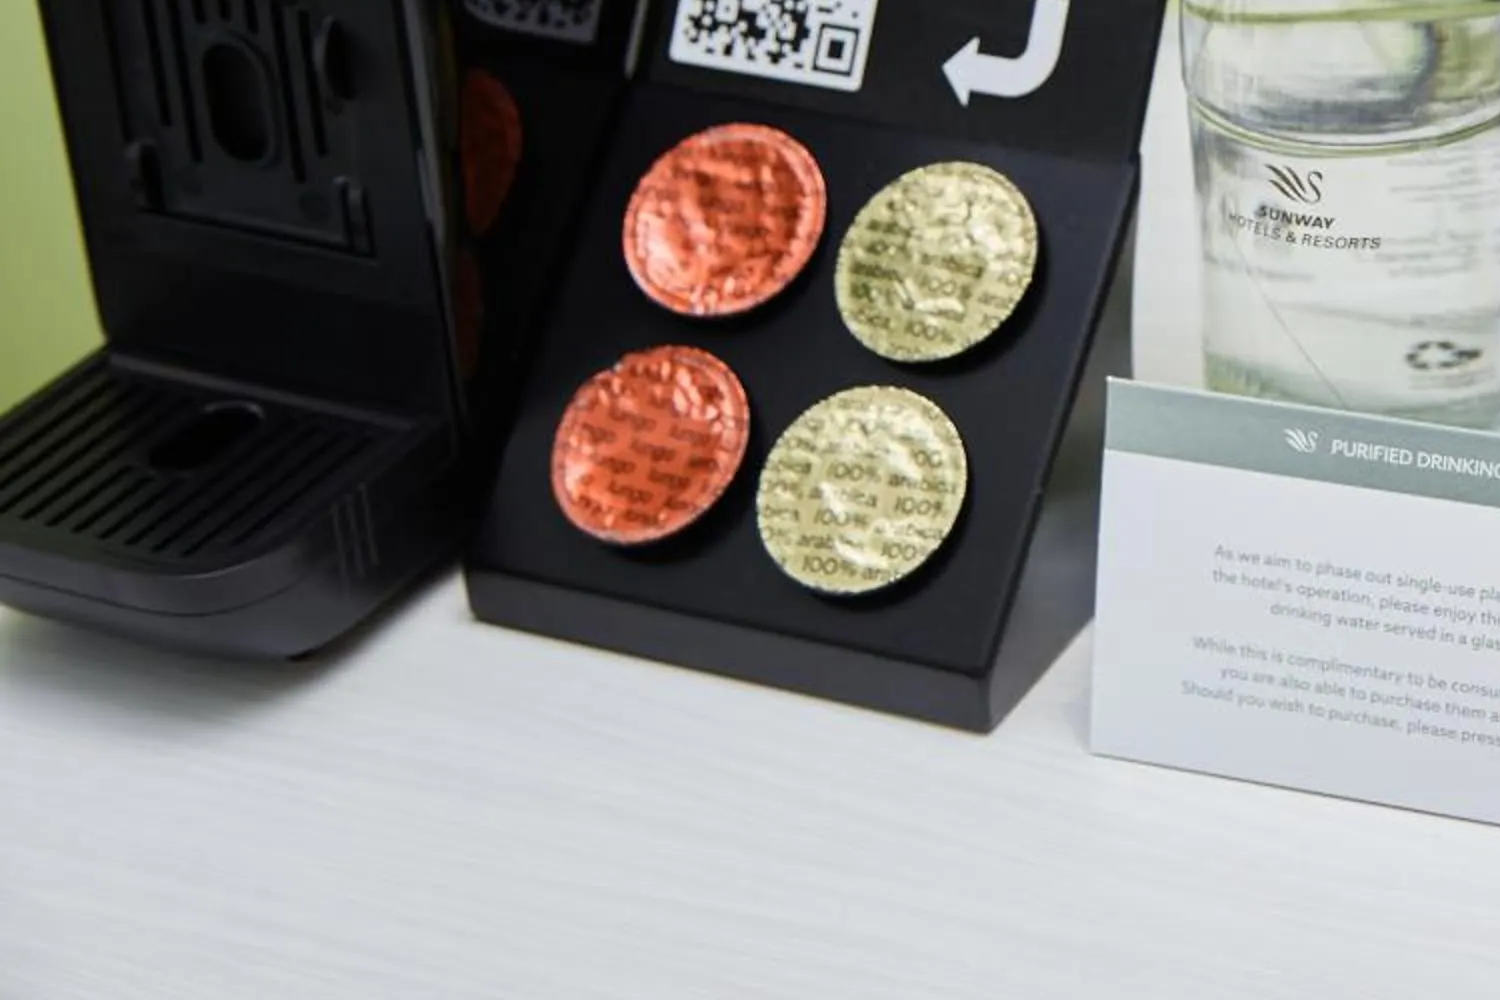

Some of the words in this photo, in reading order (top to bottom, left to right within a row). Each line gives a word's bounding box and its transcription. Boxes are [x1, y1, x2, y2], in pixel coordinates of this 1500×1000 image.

[1229, 212, 1281, 242] HOTELS
[1285, 231, 1297, 245] &
[1301, 233, 1383, 250] RESORTS
[1257, 204, 1336, 230] SUNWAY
[1331, 438, 1413, 466] PURIFIED
[1213, 568, 1237, 586] the
[1241, 572, 1293, 594] hotel's
[1296, 583, 1375, 609] operation,
[1379, 595, 1429, 616] please
[1433, 605, 1476, 625] enjoy
[1214, 544, 1234, 560] As
[1238, 551, 1260, 566] we
[1263, 552, 1291, 569] aim
[1295, 557, 1312, 573] to
[1315, 561, 1362, 583] phase
[1365, 568, 1392, 586] out
[1396, 573, 1476, 599] single-use
[1269, 602, 1332, 628] drinking
[1336, 614, 1380, 632] water
[1383, 622, 1436, 641] served
[1440, 627, 1455, 645] in
[1458, 632, 1468, 646] a
[1192, 635, 1237, 656] While
[1240, 644, 1268, 662] this
[1271, 648, 1284, 664] is
[1286, 652, 1403, 685] complimentary
[1407, 671, 1424, 687] to
[1428, 673, 1447, 692] be
[1181, 679, 1234, 702] Should
[1237, 693, 1266, 710] you
[1268, 696, 1305, 714] wish
[1308, 701, 1326, 719] to
[1407, 719, 1457, 740] please
[1219, 666, 1250, 683] you
[1252, 671, 1275, 688] are
[1280, 674, 1312, 693] also
[1315, 680, 1347, 699] able
[1350, 685, 1367, 702] to
[1370, 689, 1441, 713] purchase
[1445, 701, 1486, 721] them
